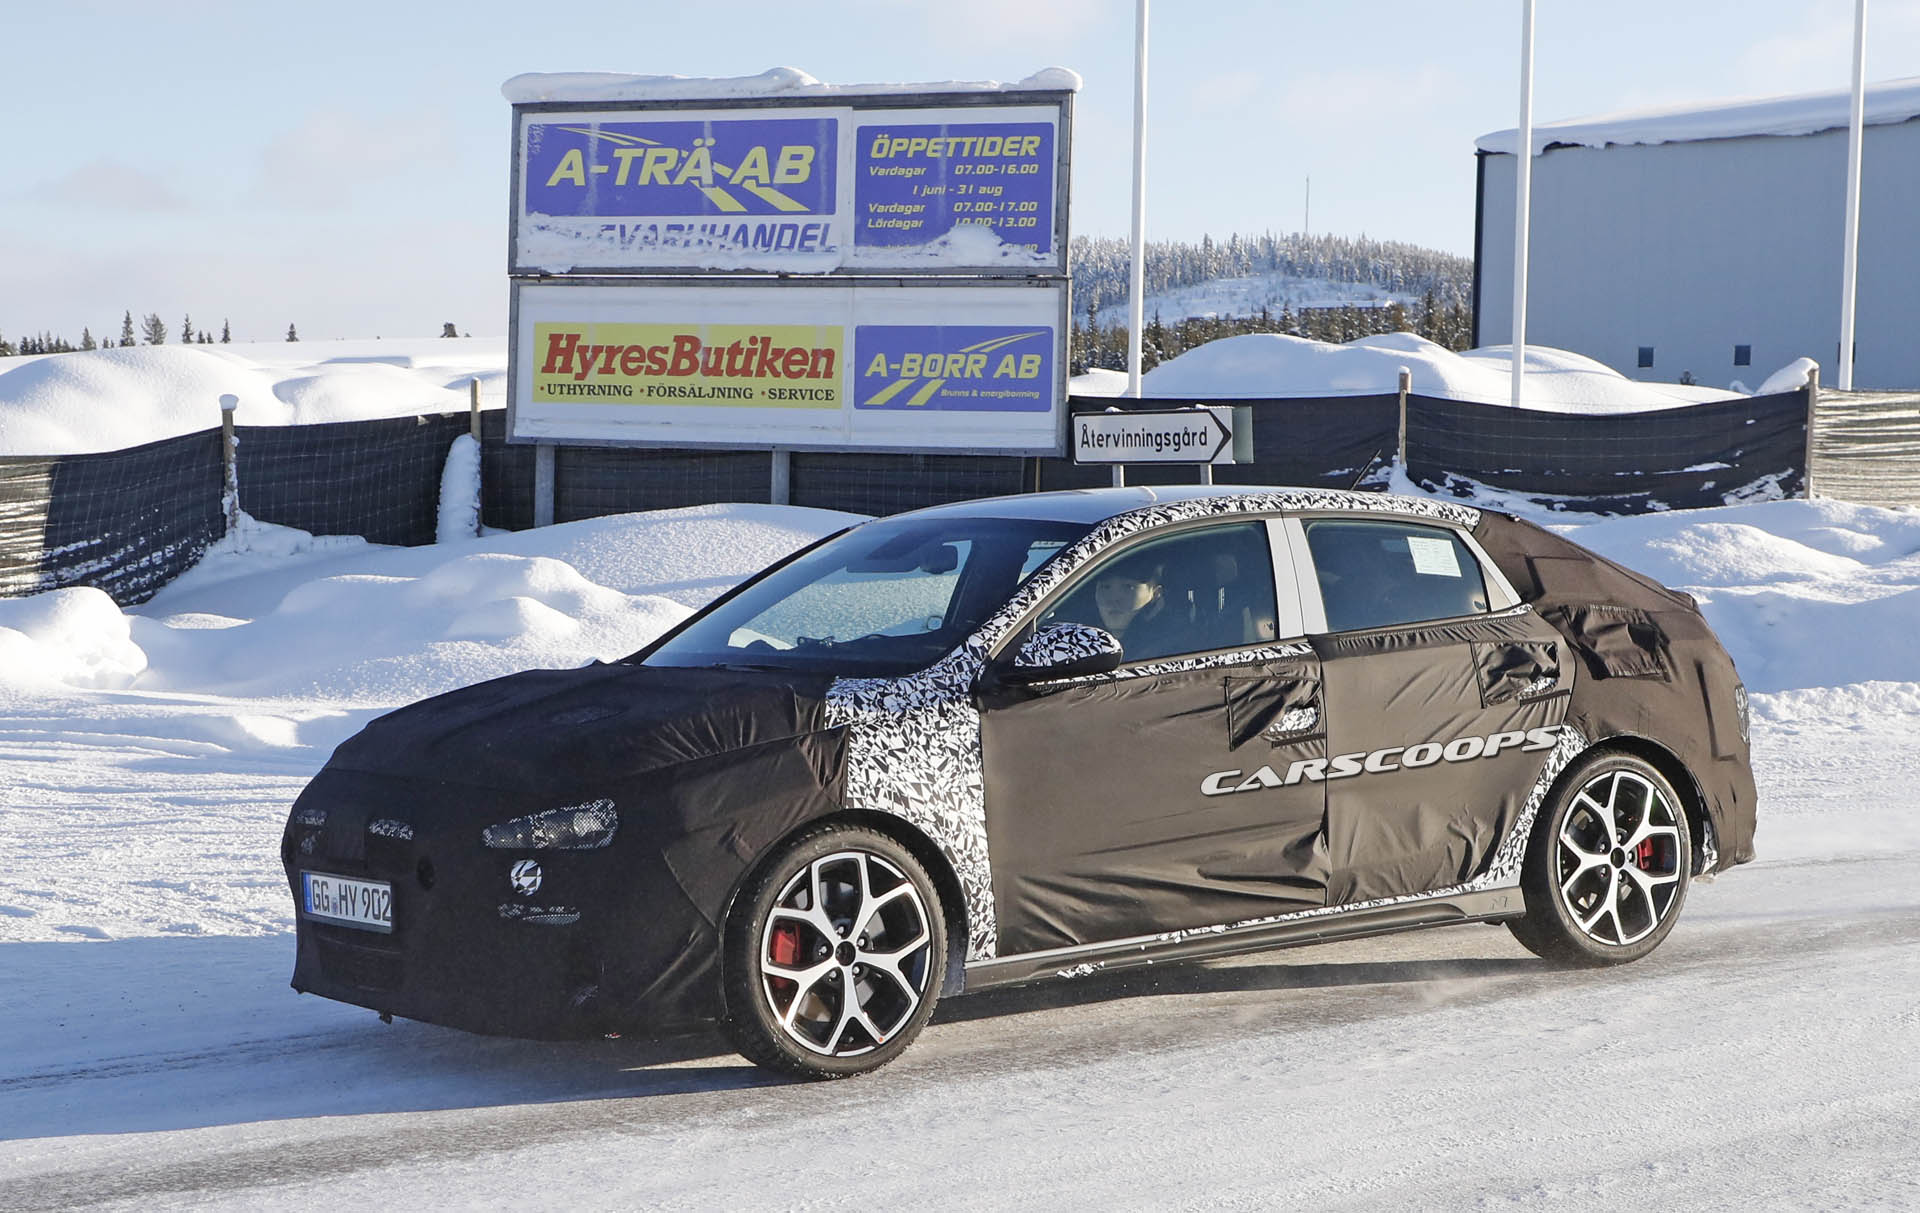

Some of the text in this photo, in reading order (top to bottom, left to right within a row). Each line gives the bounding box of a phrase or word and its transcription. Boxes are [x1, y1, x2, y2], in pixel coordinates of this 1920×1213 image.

[870, 133, 1041, 158] ÖPPETTIDER
[729, 145, 815, 185] AB
[869, 163, 1039, 177] Vardagar 07.00-16.00
[912, 184, 918, 195] 1
[921, 184, 946, 197] juni
[956, 184, 974, 195] 31
[978, 185, 1003, 197] aug
[868, 201, 1038, 214] Vardagar 07.00-17.00
[867, 217, 1037, 231] Lördagar 1000-13.00
[541, 333, 836, 380] HyresButiken
[864, 352, 1041, 380] A-BORR AB
[547, 383, 834, 401] UTHYRNING FÖRSÄLJNING SERVICE
[1081, 423, 1207, 452] Återvinningsgård
[312, 879, 392, 922] GG HY 902
